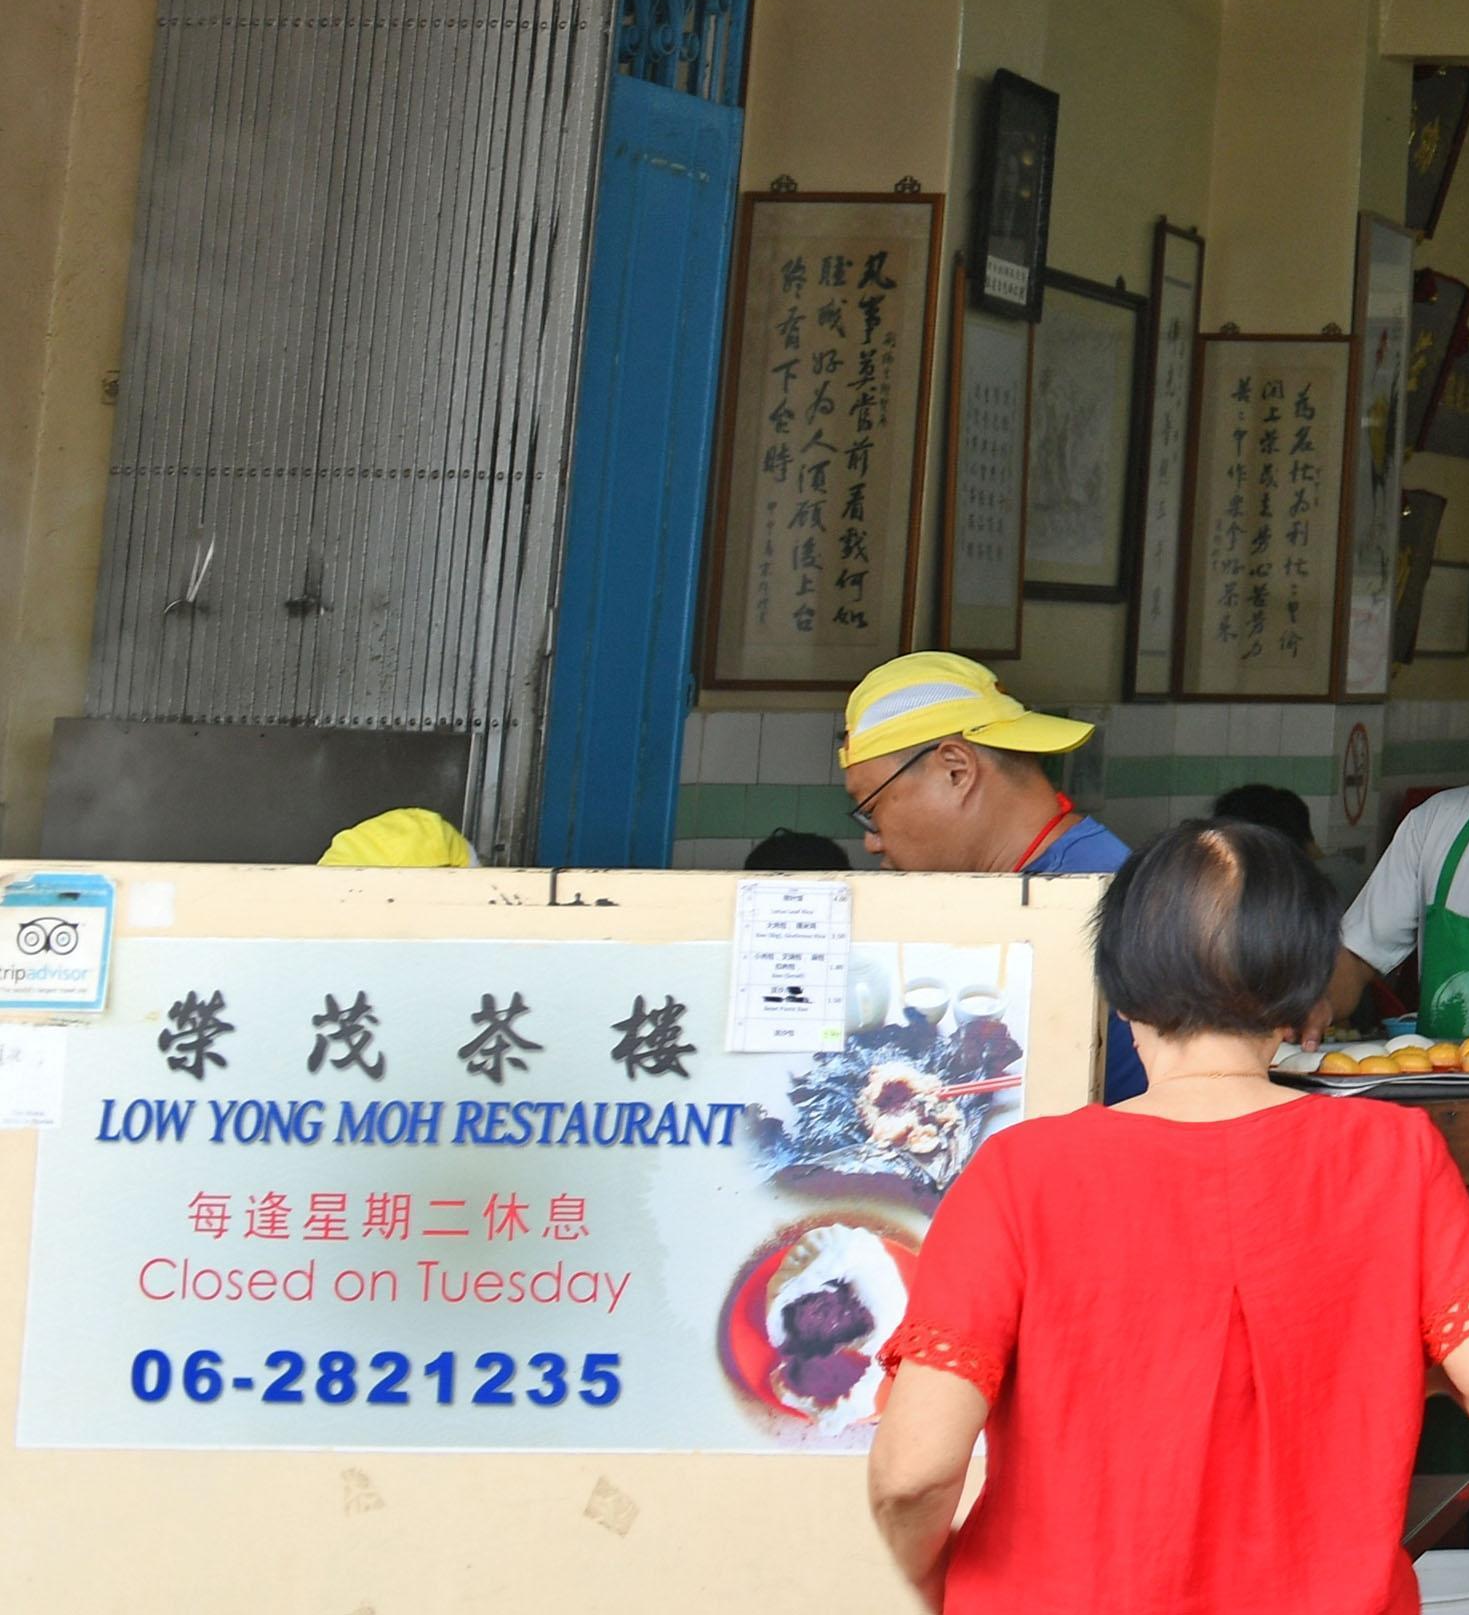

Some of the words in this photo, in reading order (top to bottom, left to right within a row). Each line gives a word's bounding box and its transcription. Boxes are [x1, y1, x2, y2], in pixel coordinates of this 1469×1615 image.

[157, 990, 698, 1082] 榮茂茶樓
[97, 1098, 199, 1147] LOW
[207, 1098, 324, 1147] YONG
[332, 1098, 441, 1147] MOH
[451, 1098, 747, 1148] RESTAURANT
[187, 1190, 591, 1242] 每逢星期二休息
[138, 1257, 316, 1303] Closed
[334, 1268, 398, 1303] on
[417, 1257, 631, 1315] Tuesday
[130, 1347, 624, 1407] 06-2821235
